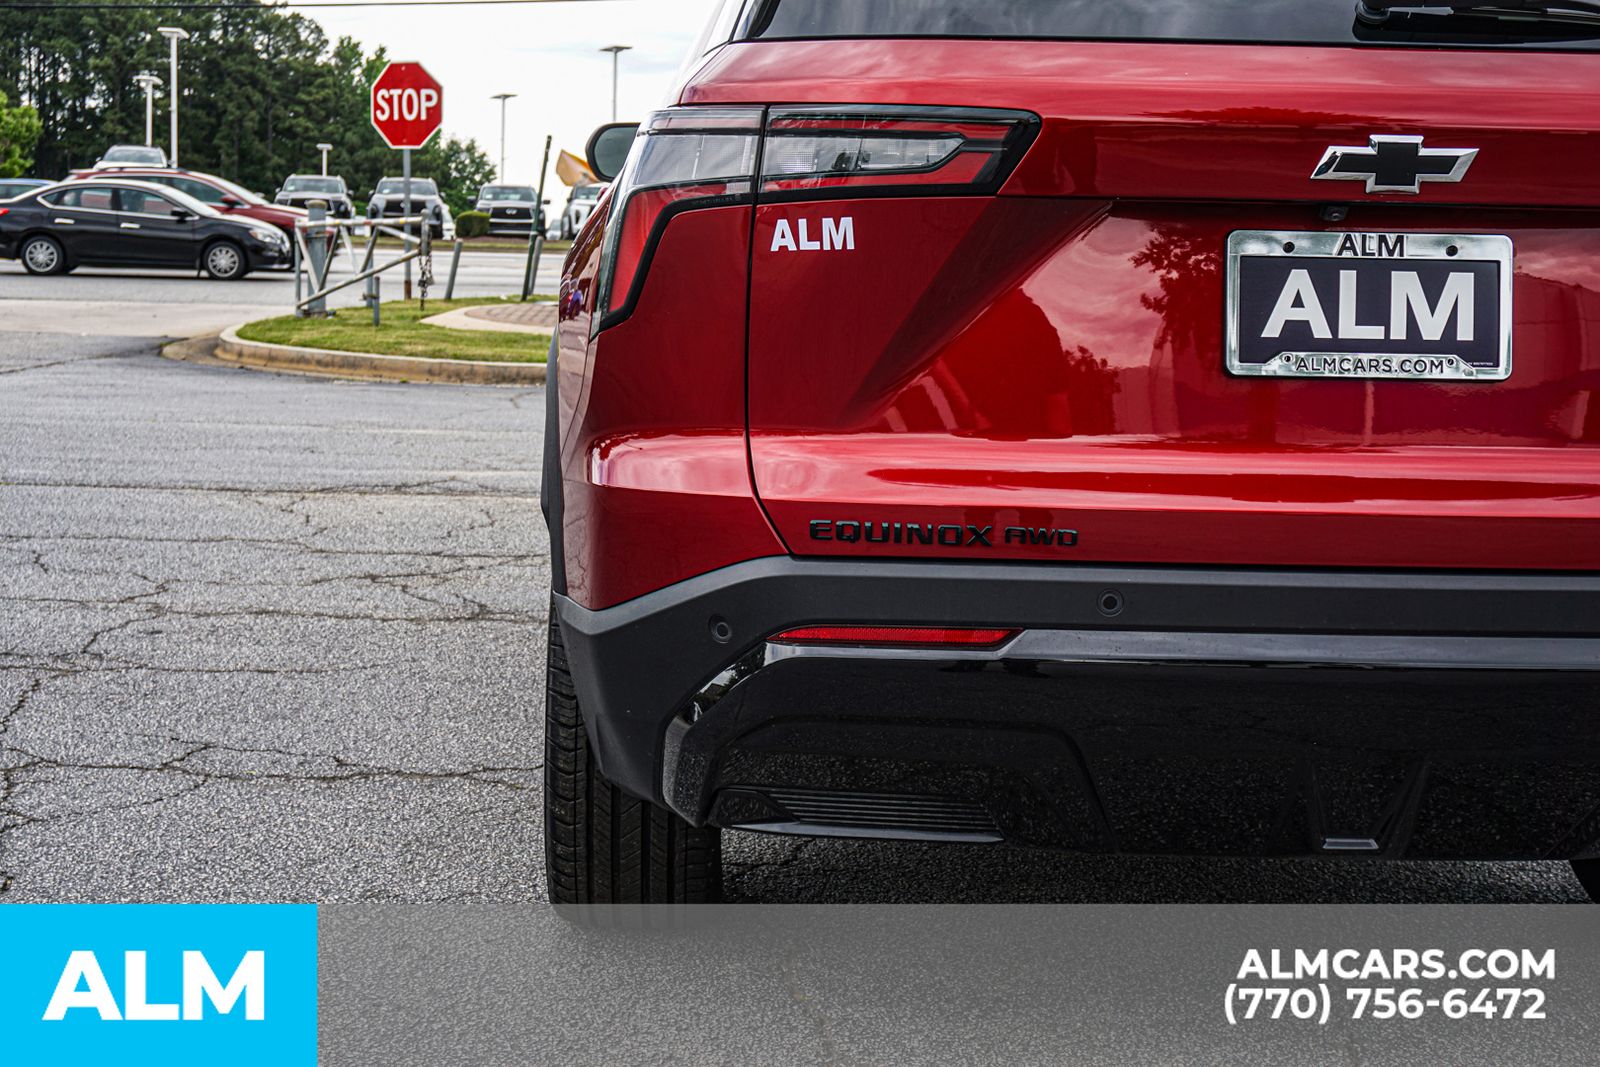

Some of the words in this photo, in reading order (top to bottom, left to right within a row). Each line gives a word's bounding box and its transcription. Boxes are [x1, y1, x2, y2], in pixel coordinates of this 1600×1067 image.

[376, 88, 438, 121] STOP
[770, 216, 855, 251] ALM
[1337, 233, 1405, 257] ALM
[1260, 269, 1475, 341] ALM
[1295, 357, 1444, 374] ALMCARS.COM
[809, 519, 993, 547] EQUINOX
[1004, 526, 1079, 546] AWD
